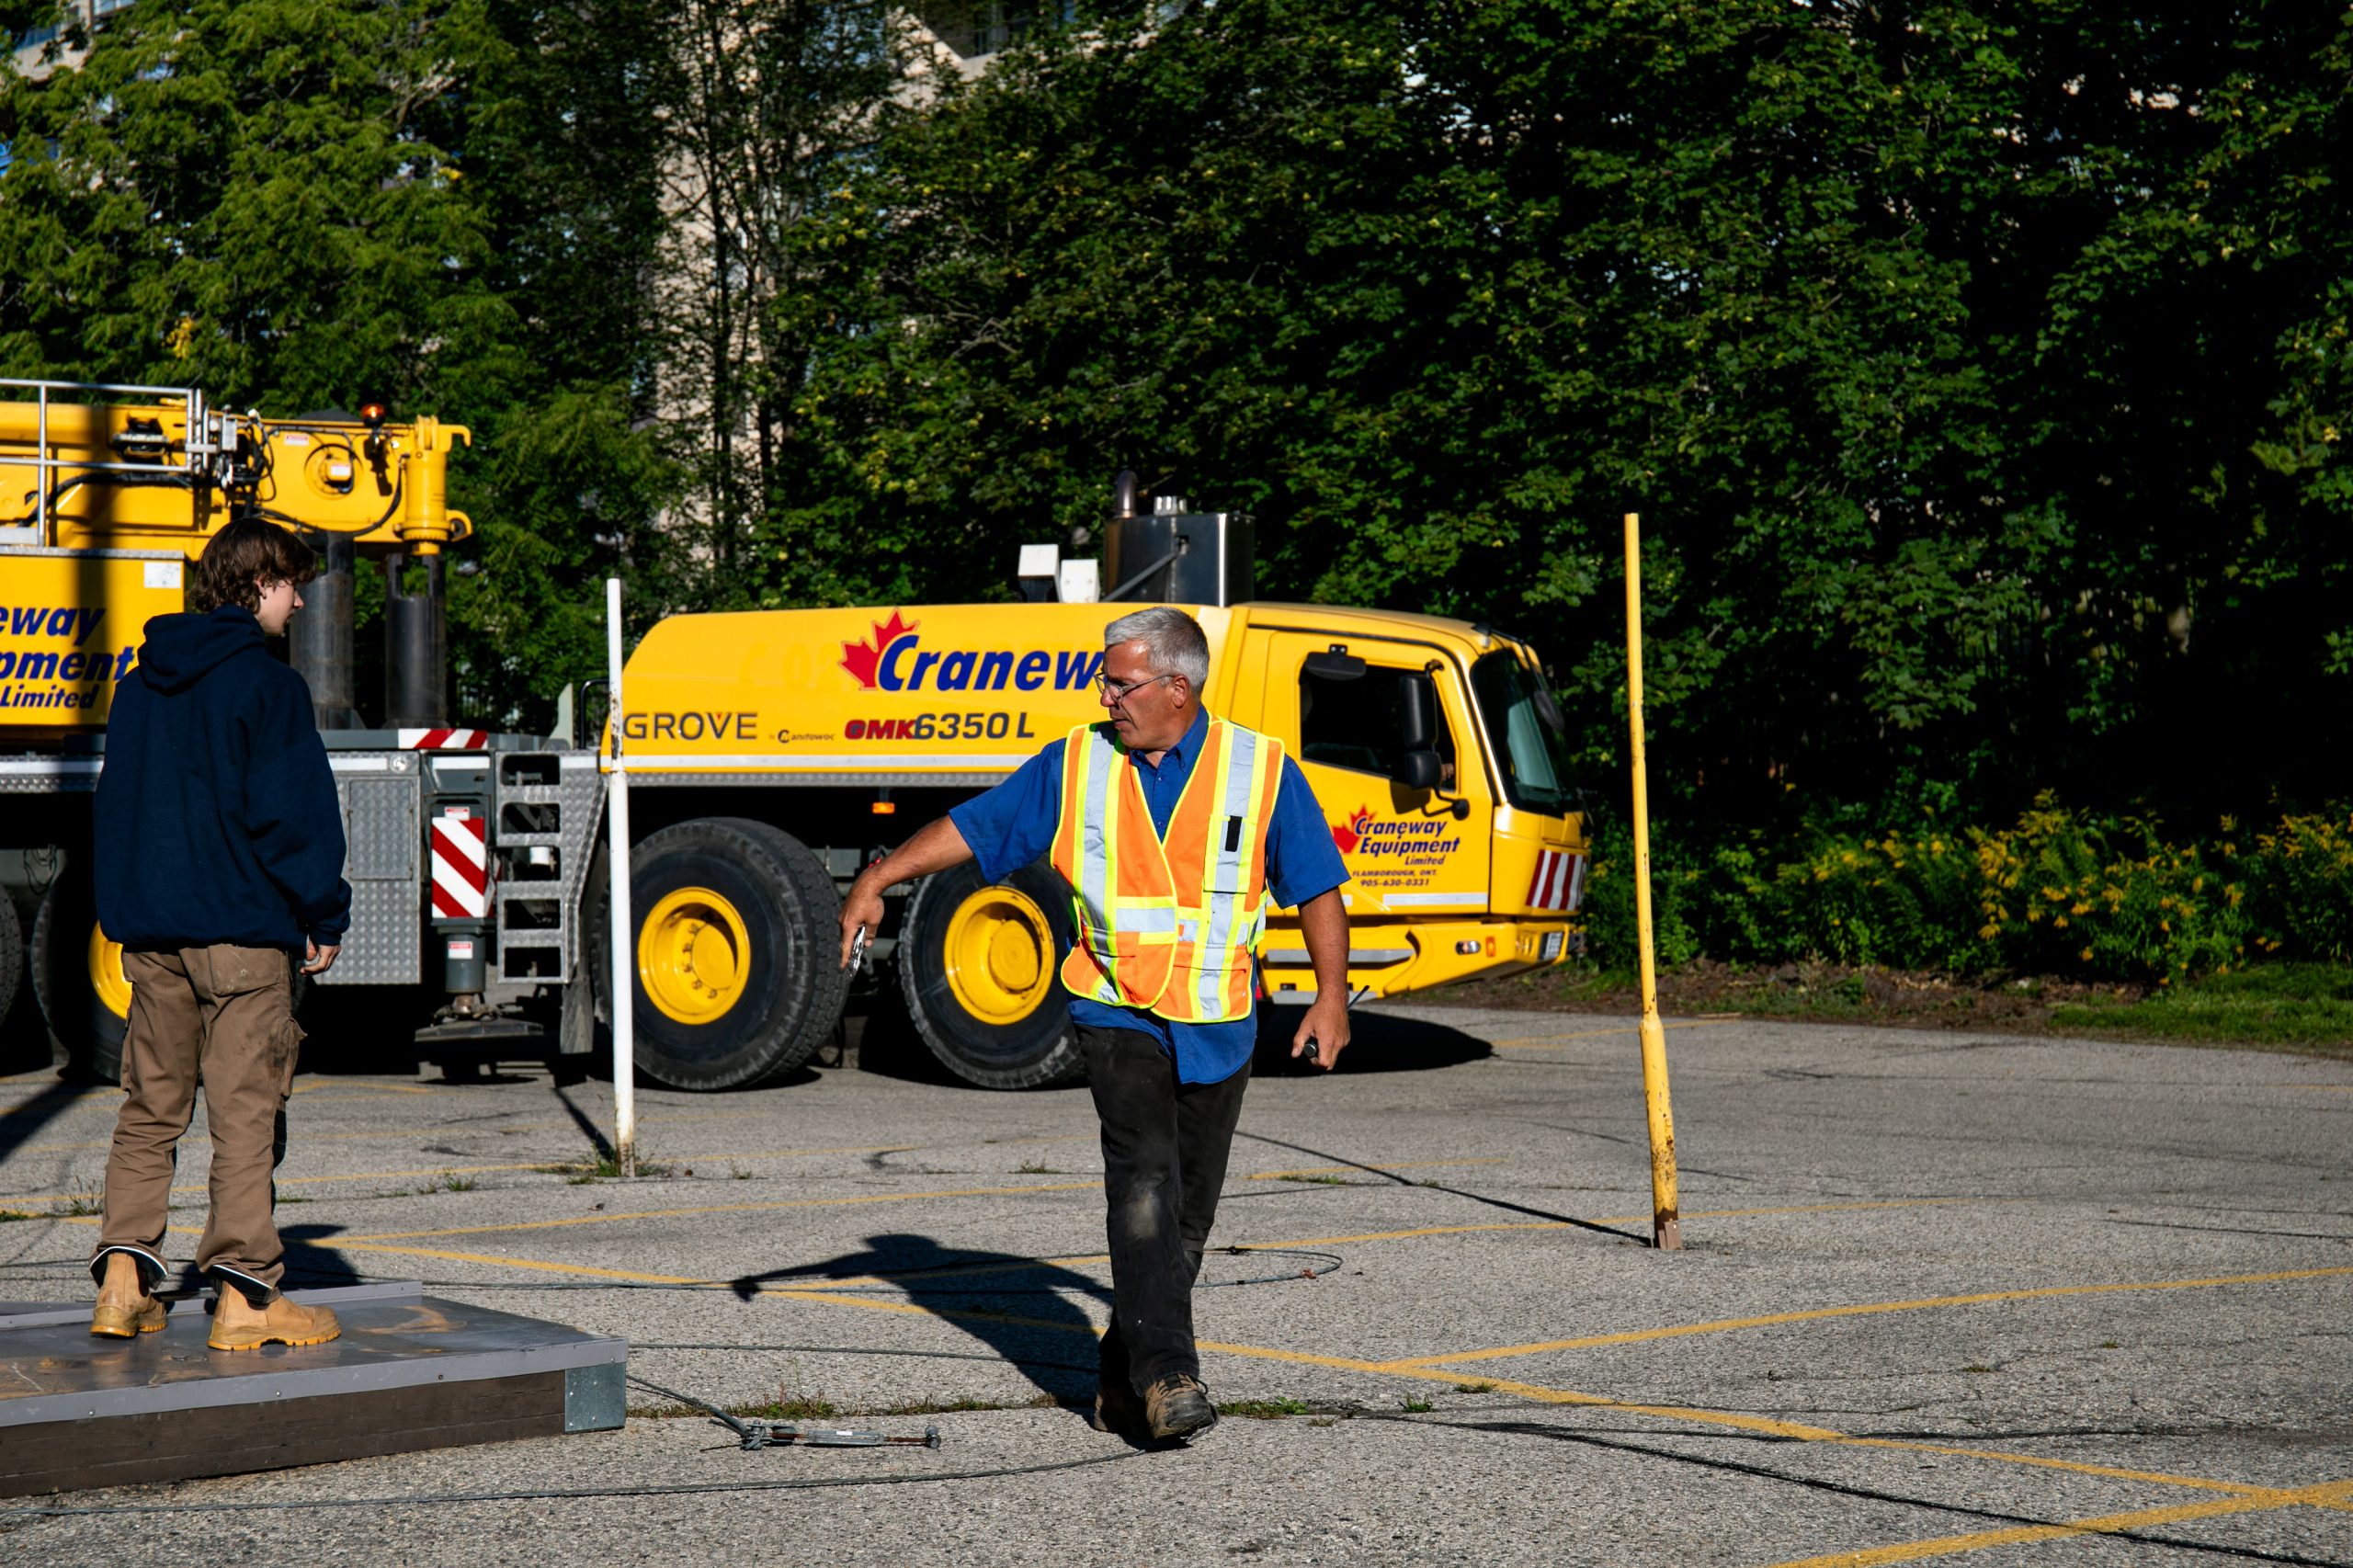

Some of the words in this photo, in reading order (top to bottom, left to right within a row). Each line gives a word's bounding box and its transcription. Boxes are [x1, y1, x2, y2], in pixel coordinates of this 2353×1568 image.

[0, 684, 100, 709] Limited
[622, 711, 758, 741] GROVE
[1355, 817, 1447, 837] Craneway
[1359, 835, 1461, 858] Equipment
[1404, 855, 1446, 866] Limited
